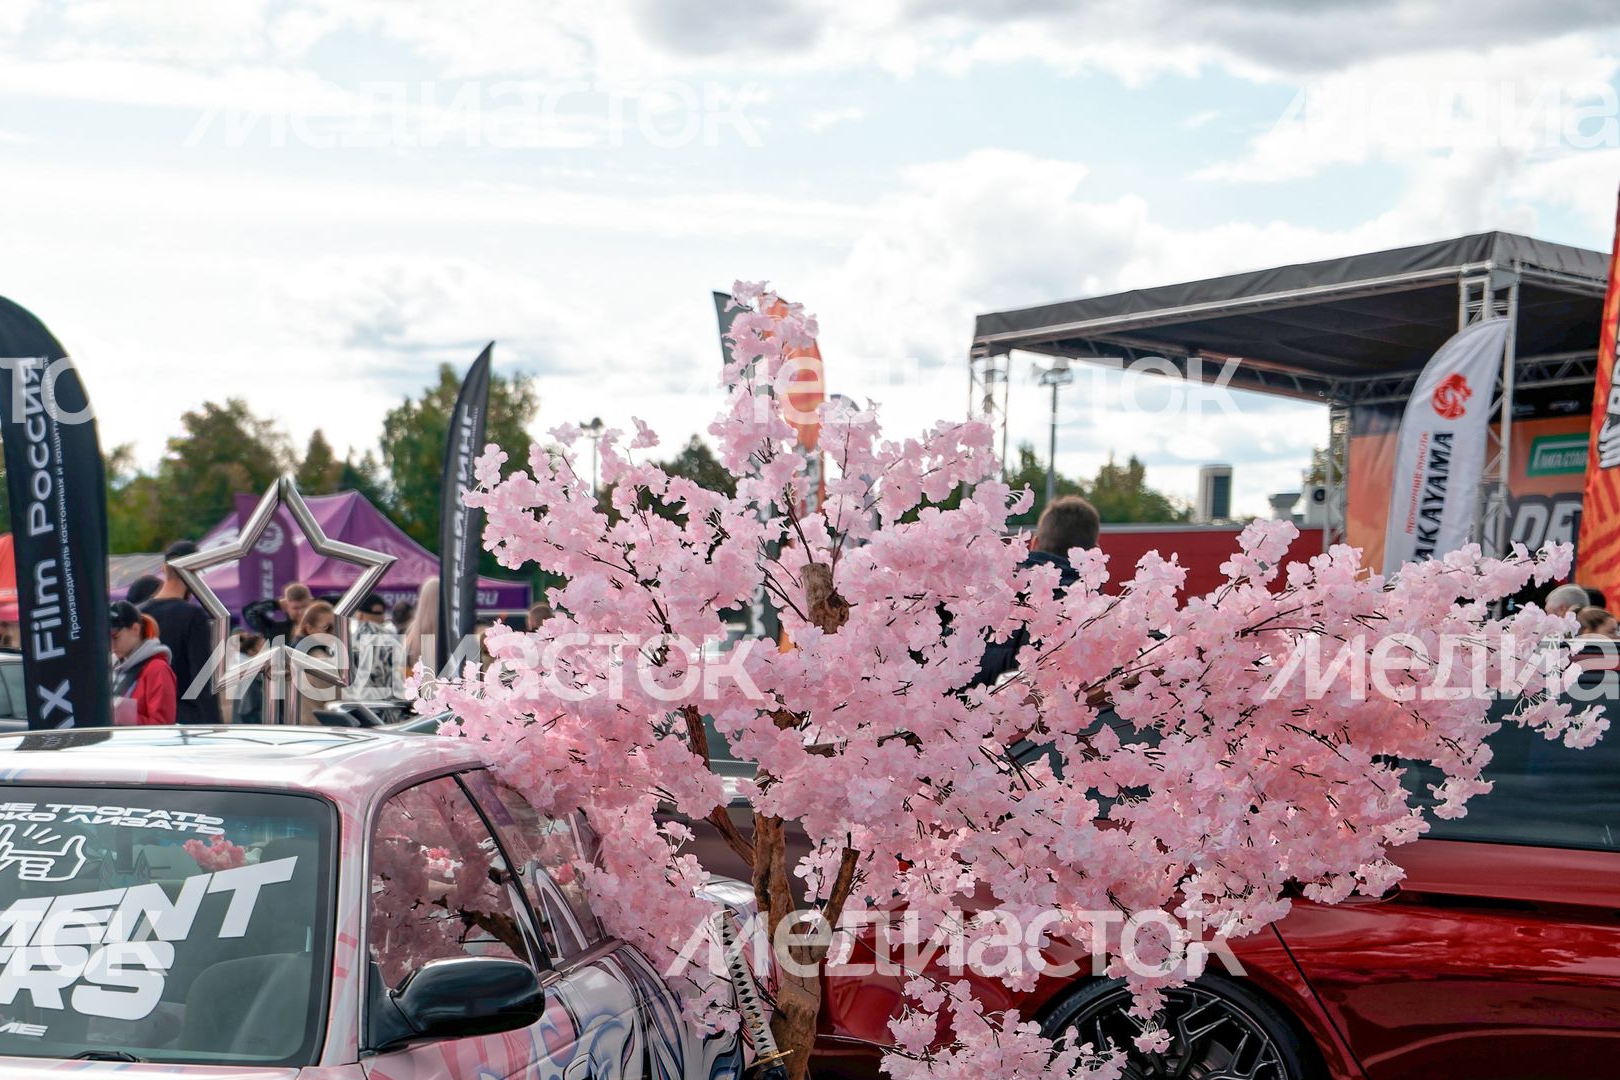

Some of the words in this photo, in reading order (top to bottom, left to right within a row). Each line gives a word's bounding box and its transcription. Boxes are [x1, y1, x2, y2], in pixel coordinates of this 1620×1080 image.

[18, 356, 54, 537] Россия
[56, 477, 70, 544] кастомных
[1412, 430, 1453, 563] AKAYAMA
[32, 558, 66, 661] Film
[61, 546, 80, 641] Производитель
[45, 803, 225, 825] ТРОГАТЬ
[63, 814, 226, 835] ЛИЗАТЬ
